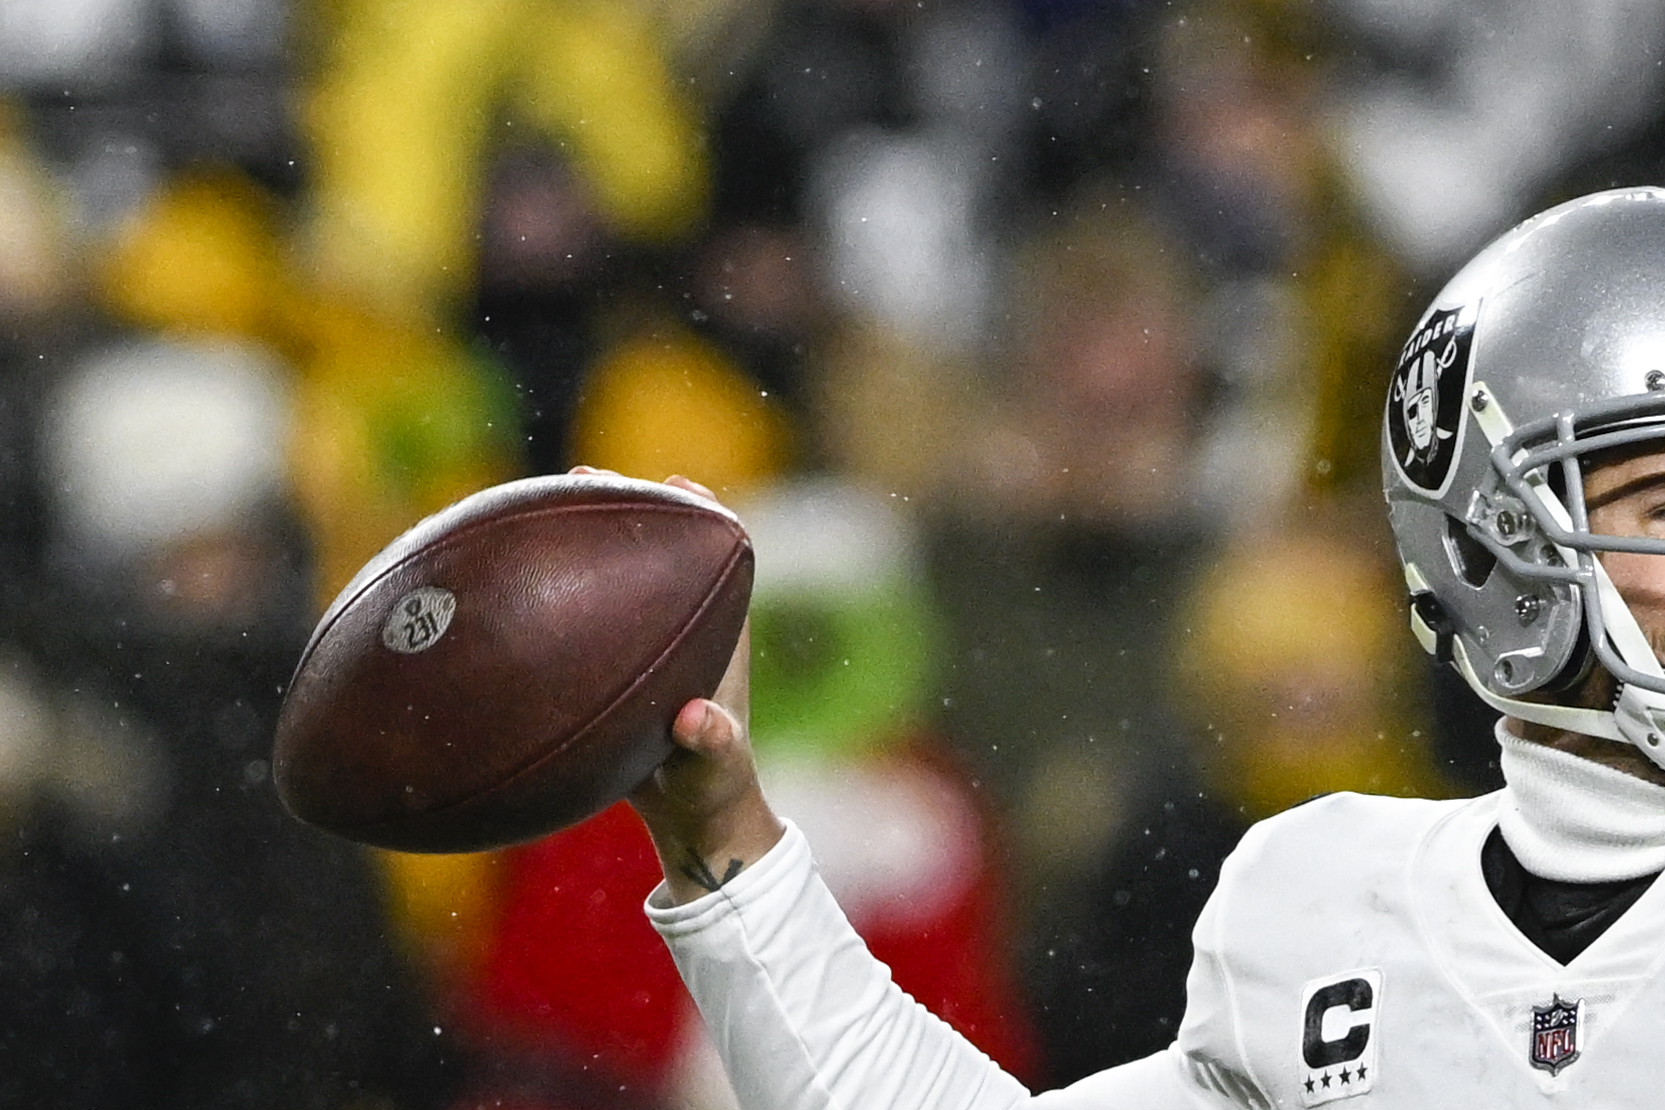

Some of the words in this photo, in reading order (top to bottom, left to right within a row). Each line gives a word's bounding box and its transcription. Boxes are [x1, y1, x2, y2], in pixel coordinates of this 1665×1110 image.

[1398, 308, 1464, 369] RAIDER
[1302, 977, 1373, 1069] C
[1535, 1028, 1575, 1060] NFL
